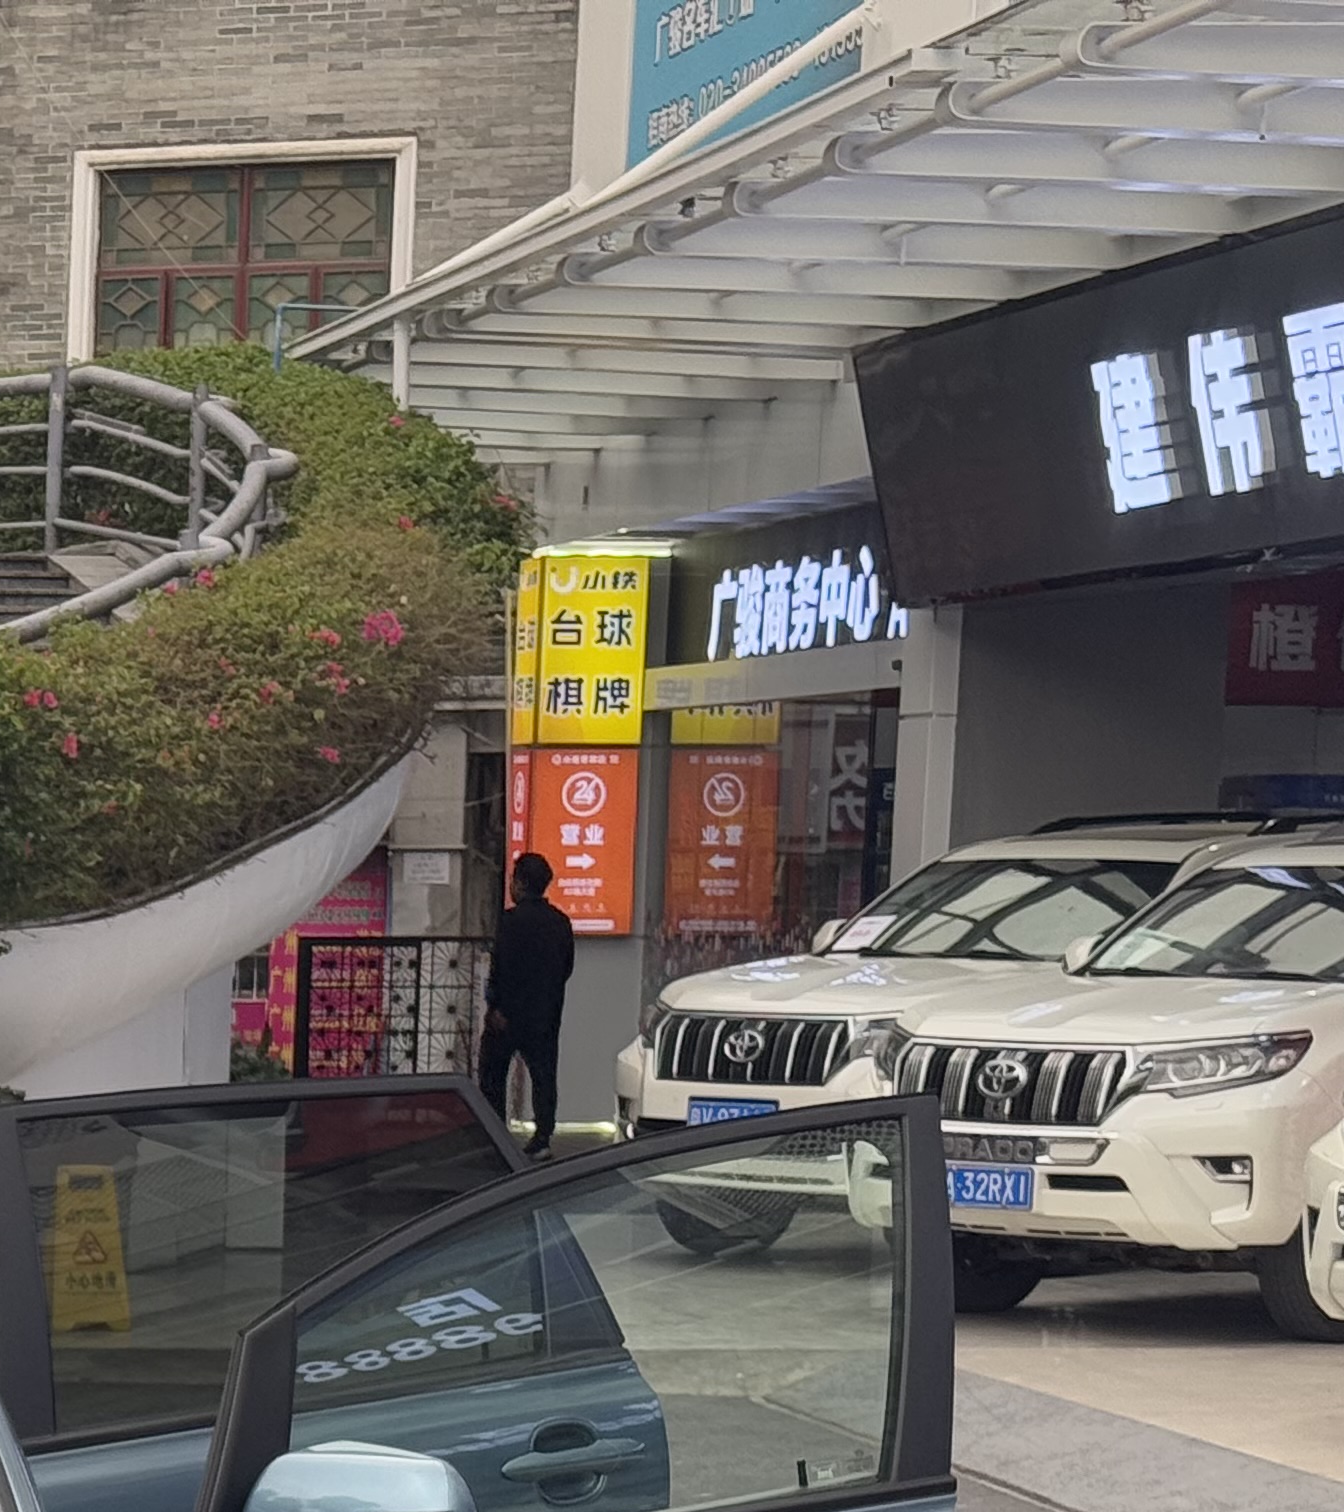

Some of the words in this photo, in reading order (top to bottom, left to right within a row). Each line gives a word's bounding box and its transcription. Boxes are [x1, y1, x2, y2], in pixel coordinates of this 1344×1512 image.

[550, 608, 634, 646] 台球
[707, 545, 879, 662] 广骏商务中心
[1248, 603, 1344, 672] 橙
[546, 677, 630, 714] 棋牌
